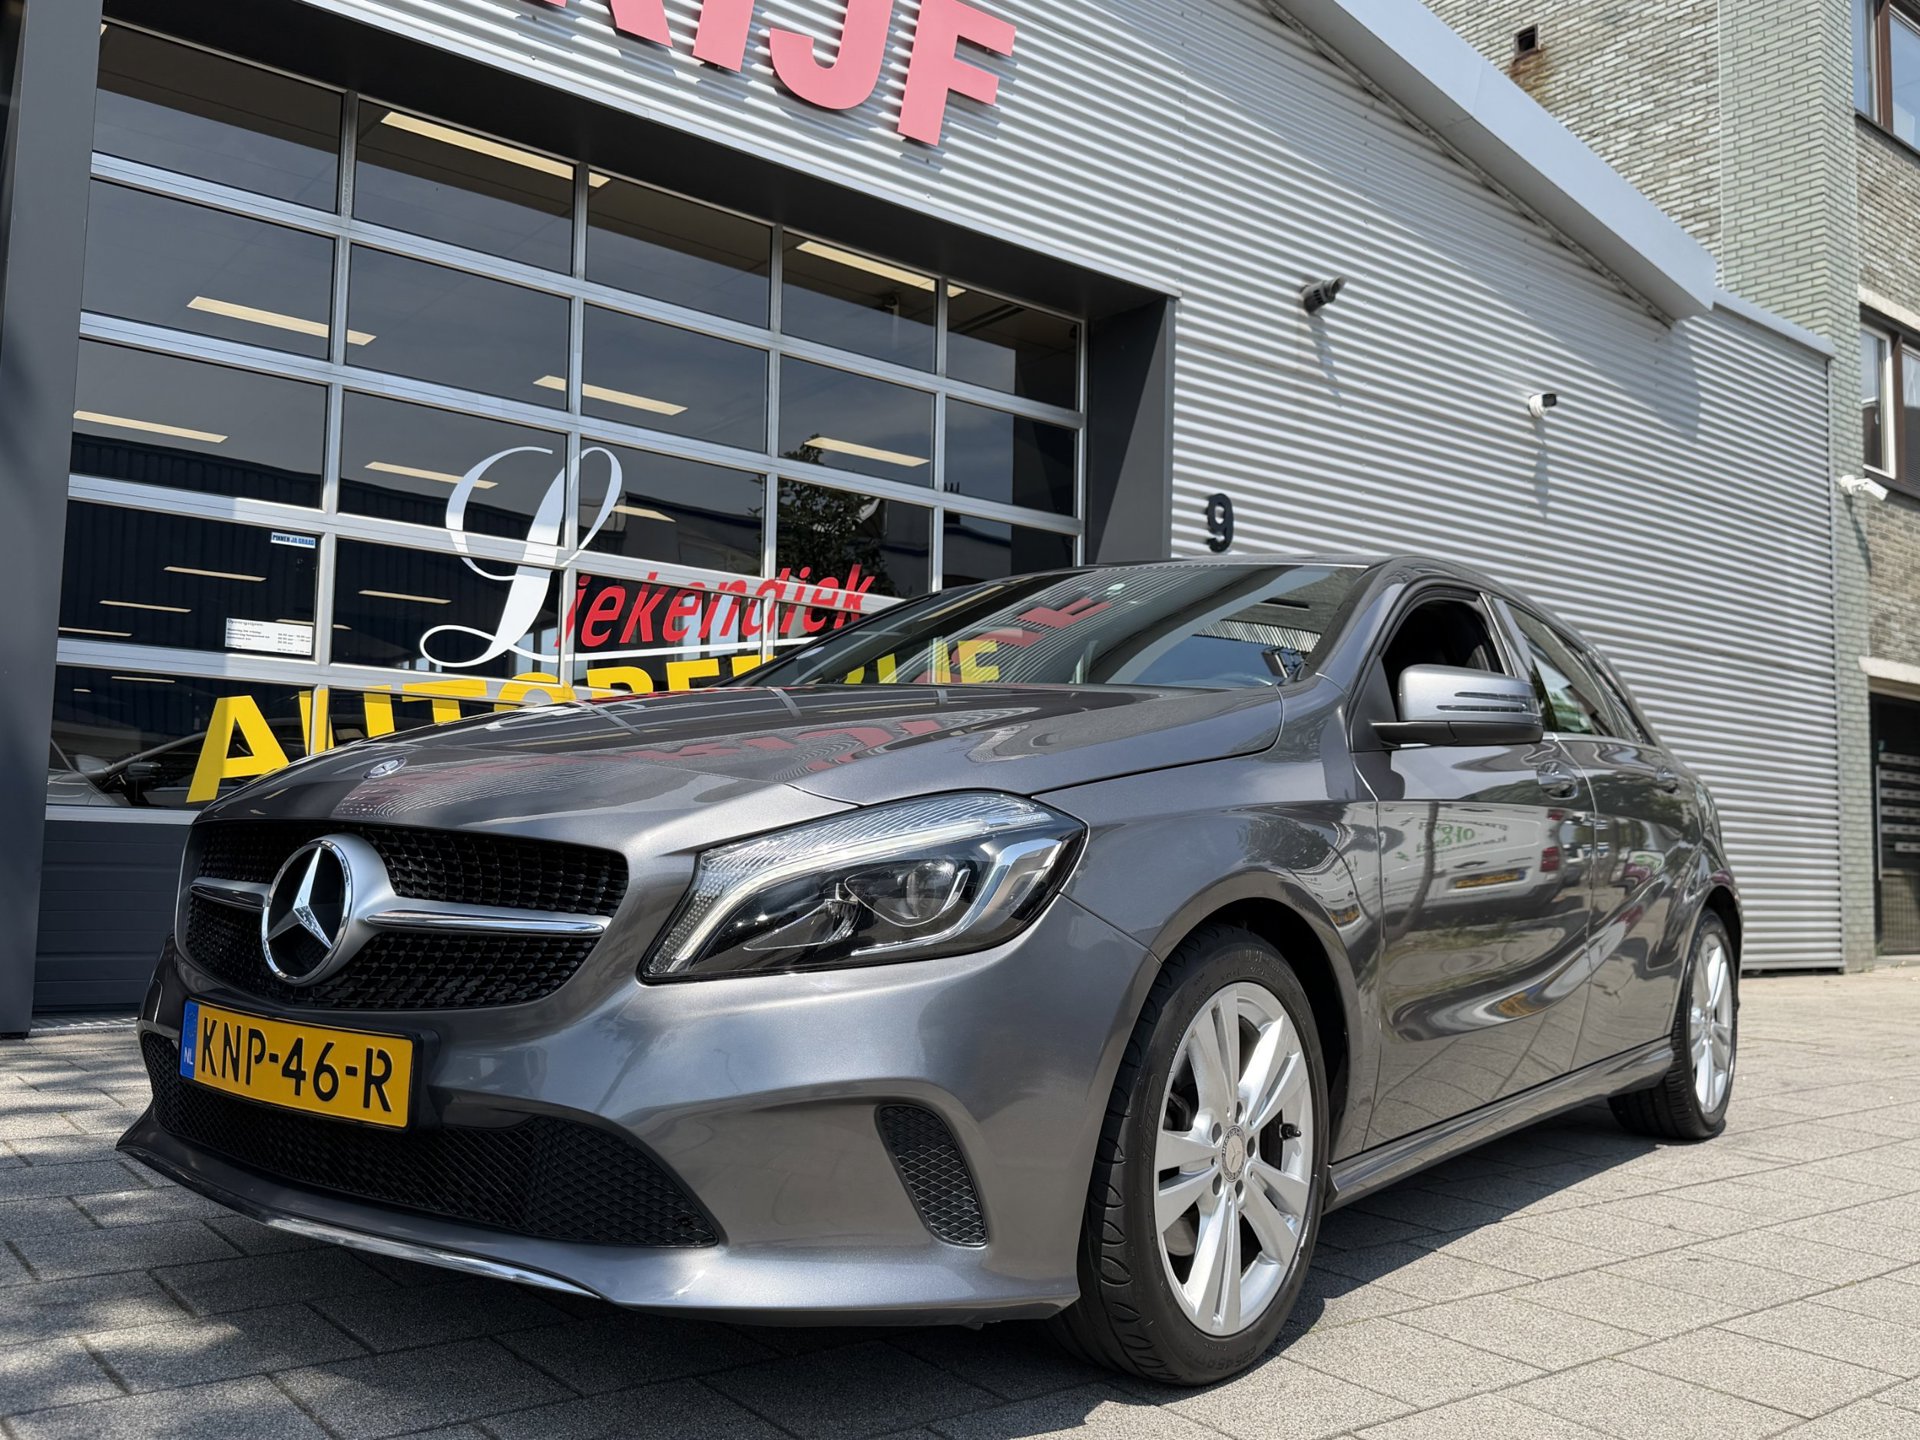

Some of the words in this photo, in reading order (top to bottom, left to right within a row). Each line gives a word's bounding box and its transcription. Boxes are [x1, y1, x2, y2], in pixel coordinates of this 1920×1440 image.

[1206, 493, 1234, 553] 9
[183, 1046, 194, 1066] NL
[201, 1016, 393, 1113] KNP-46-R
